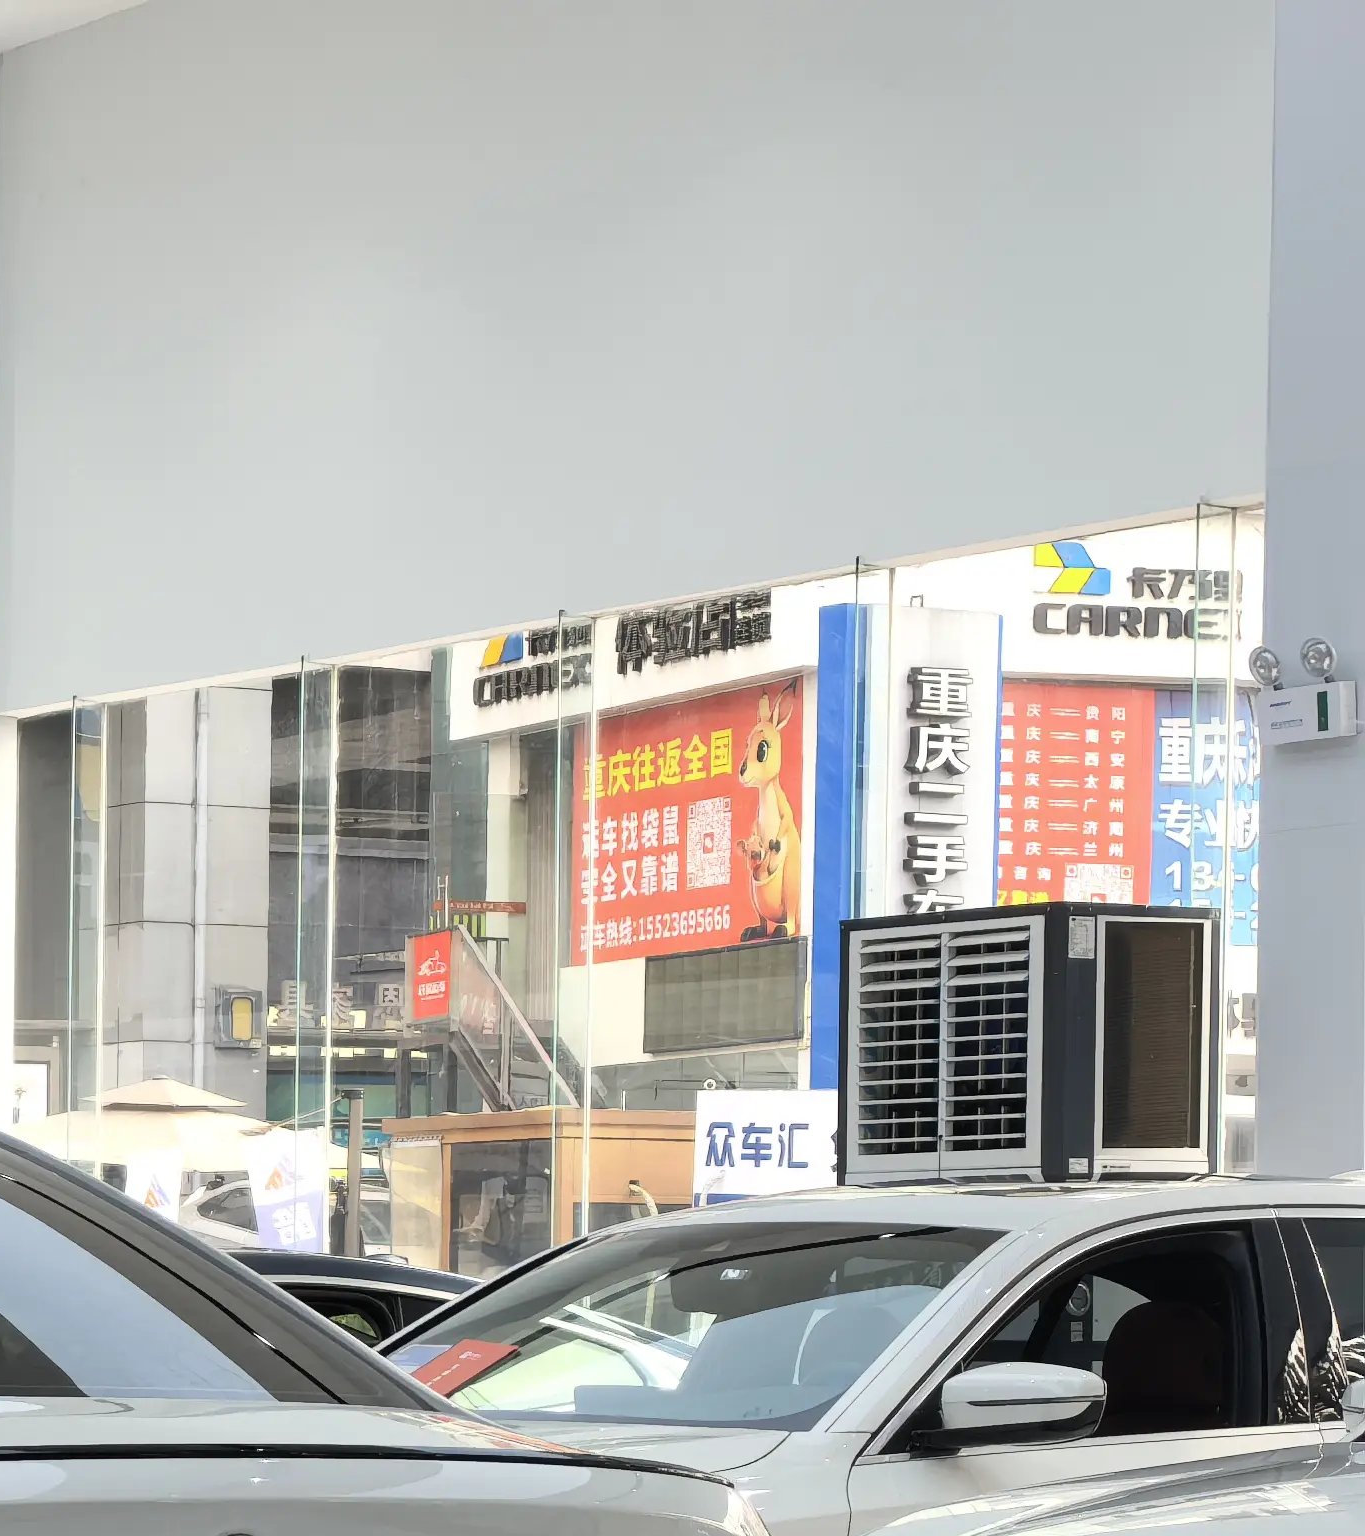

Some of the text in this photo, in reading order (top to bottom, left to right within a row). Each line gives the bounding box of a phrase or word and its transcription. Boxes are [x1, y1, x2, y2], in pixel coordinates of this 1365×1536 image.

[1032, 602, 1242, 641] CARNE
[583, 728, 733, 801] 重庆往返全国
[705, 1121, 810, 1168] 众车汇
